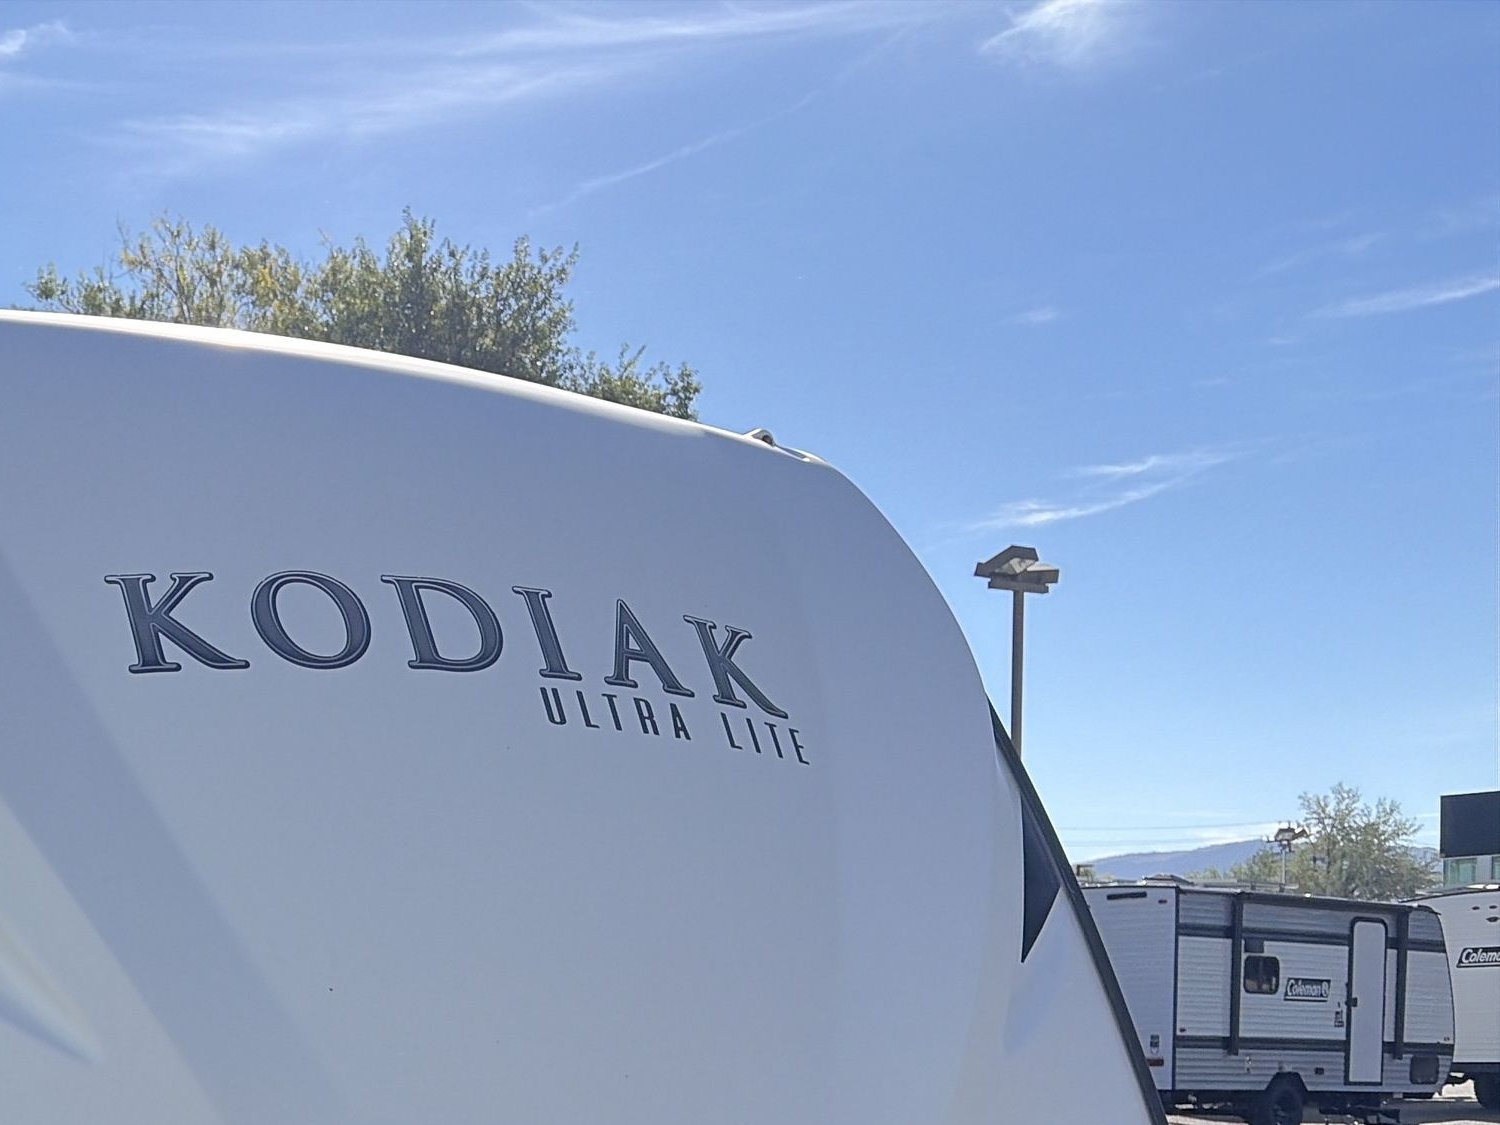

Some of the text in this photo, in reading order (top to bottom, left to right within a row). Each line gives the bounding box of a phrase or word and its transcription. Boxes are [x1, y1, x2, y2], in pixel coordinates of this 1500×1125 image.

[104, 570, 789, 720] KODIAK
[539, 686, 810, 766] ULTRA LITE
[1287, 979, 1321, 996] Coleman
